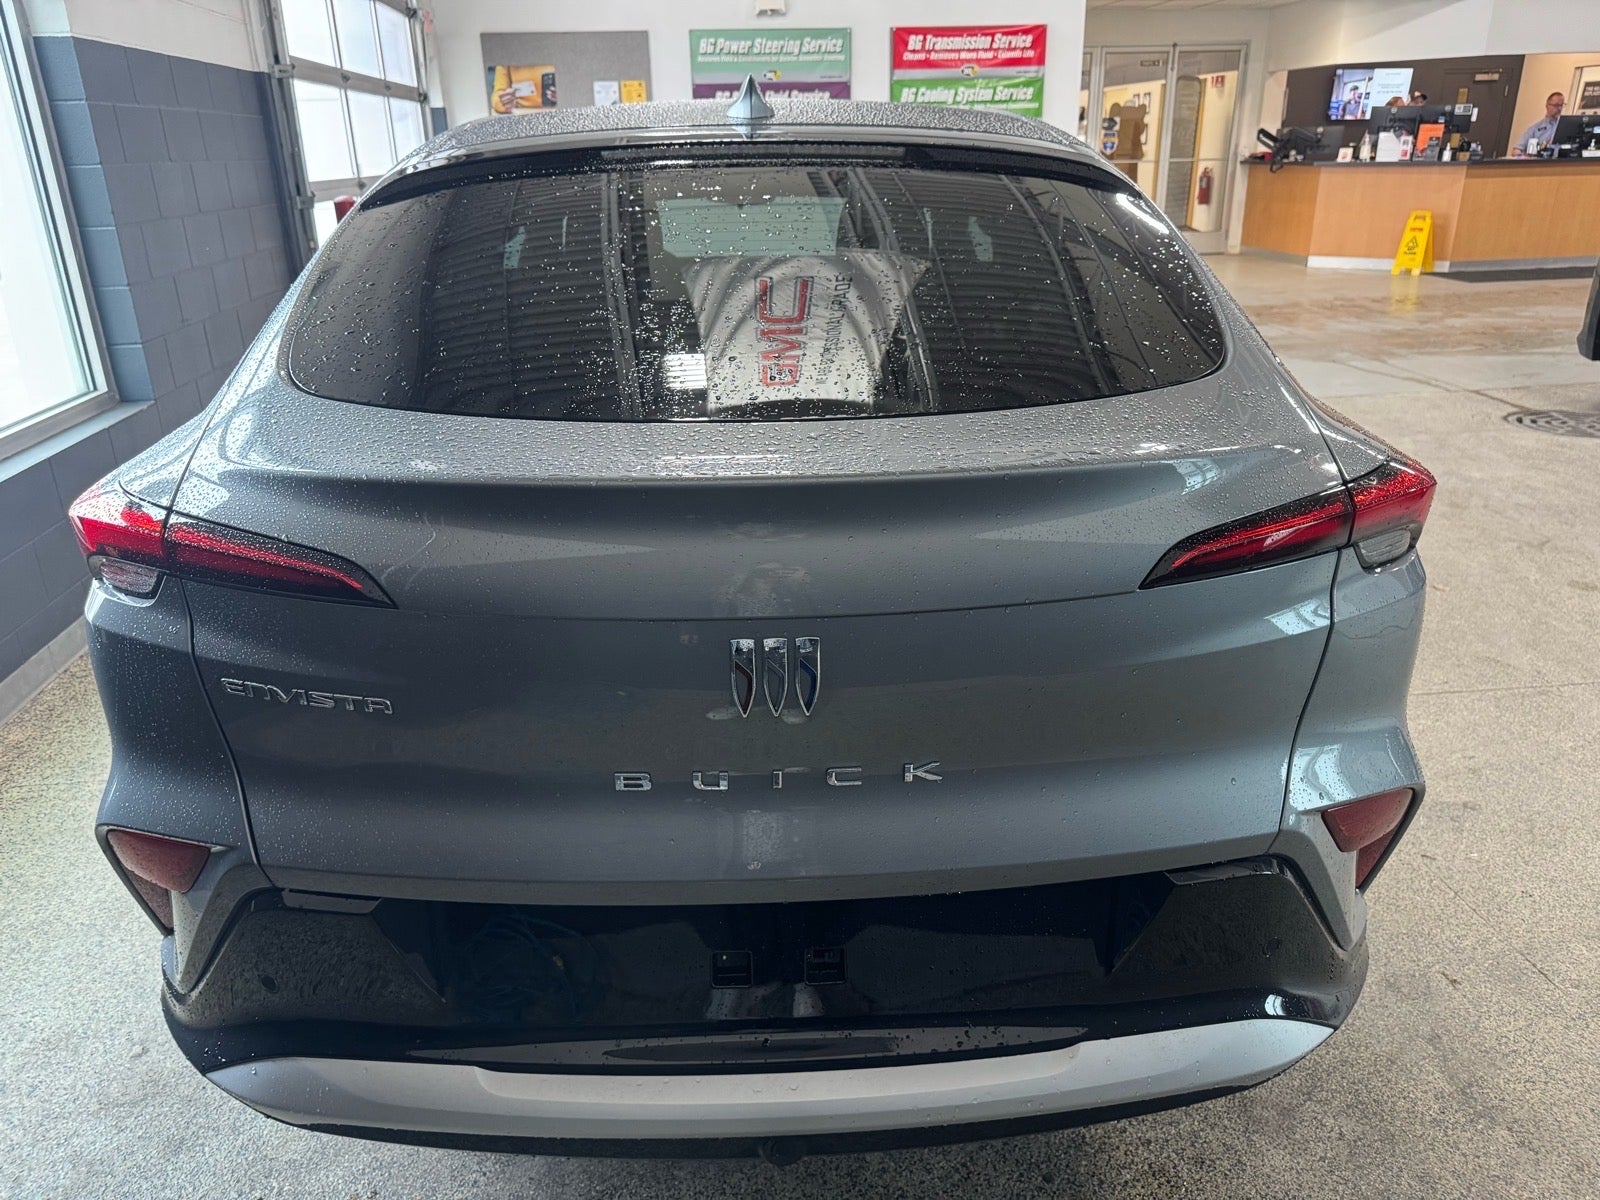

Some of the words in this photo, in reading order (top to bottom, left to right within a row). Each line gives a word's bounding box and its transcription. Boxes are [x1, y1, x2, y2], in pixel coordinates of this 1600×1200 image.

[699, 37, 715, 54] BG
[716, 38, 752, 54] Power
[753, 37, 801, 56] Steering
[802, 37, 844, 53] Service
[907, 34, 923, 51] BG
[925, 34, 992, 50] Transmission
[992, 33, 1033, 48] Service
[901, 87, 916, 103] BG
[916, 86, 955, 104] Cooling
[956, 86, 994, 104] System
[995, 86, 1034, 101] Service
[754, 276, 814, 388] GMC
[220, 677, 393, 715] ENVISTA
[614, 760, 943, 793] BUICK
